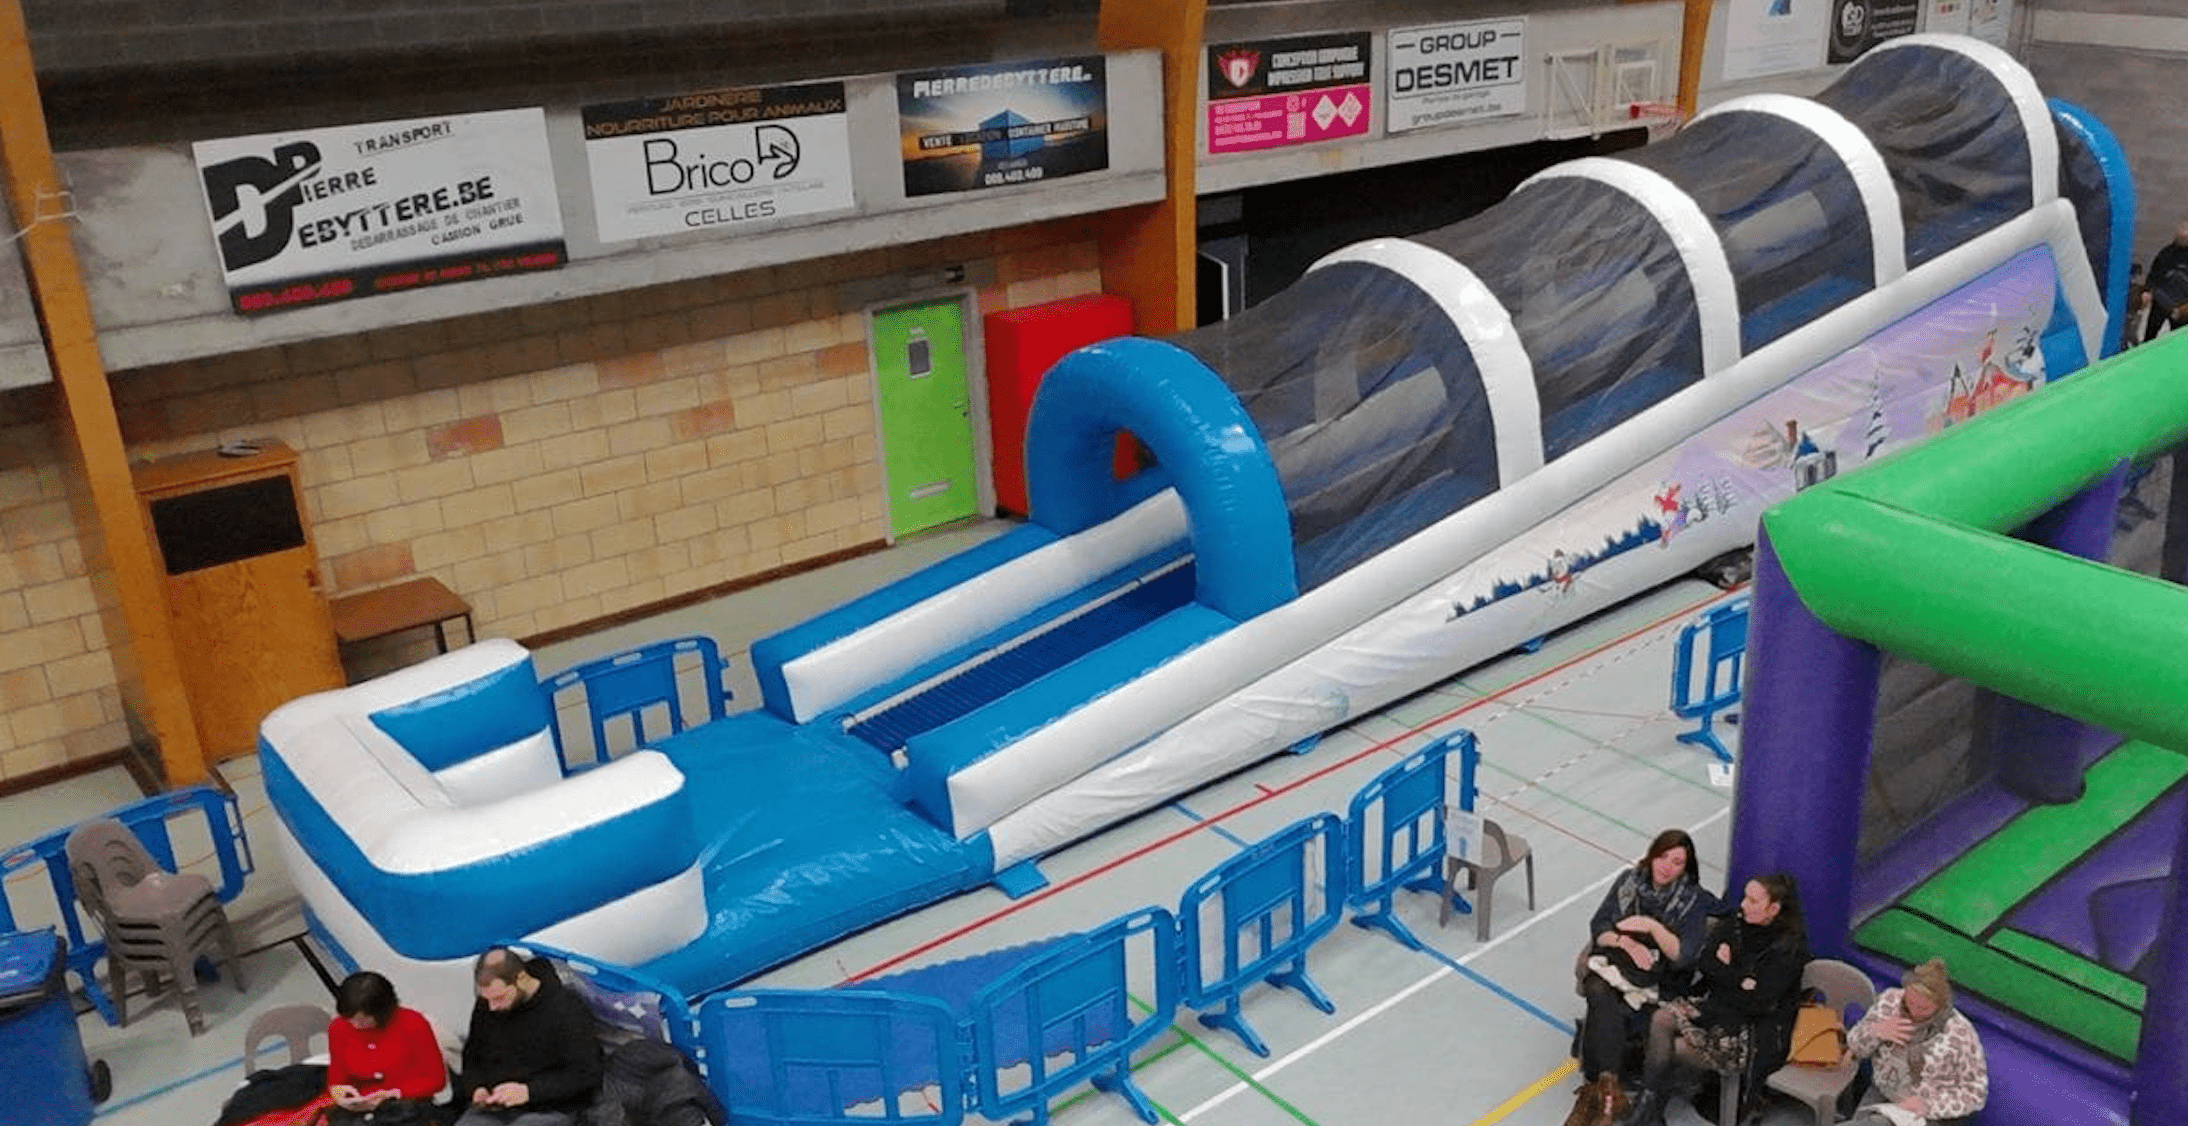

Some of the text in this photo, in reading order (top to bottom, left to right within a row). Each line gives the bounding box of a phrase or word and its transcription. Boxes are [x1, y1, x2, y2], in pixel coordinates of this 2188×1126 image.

[1419, 30, 1497, 54] GROUP
[1395, 56, 1519, 92] DESMET
[587, 98, 843, 137] NOURRITURE POUR ANIMAUX
[354, 120, 454, 154] TRANSPORT
[922, 134, 953, 149] VENTE
[444, 214, 460, 226] DE
[465, 198, 522, 220] CHANTIER
[489, 213, 524, 230] GRUE
[685, 200, 777, 227] CELLES
